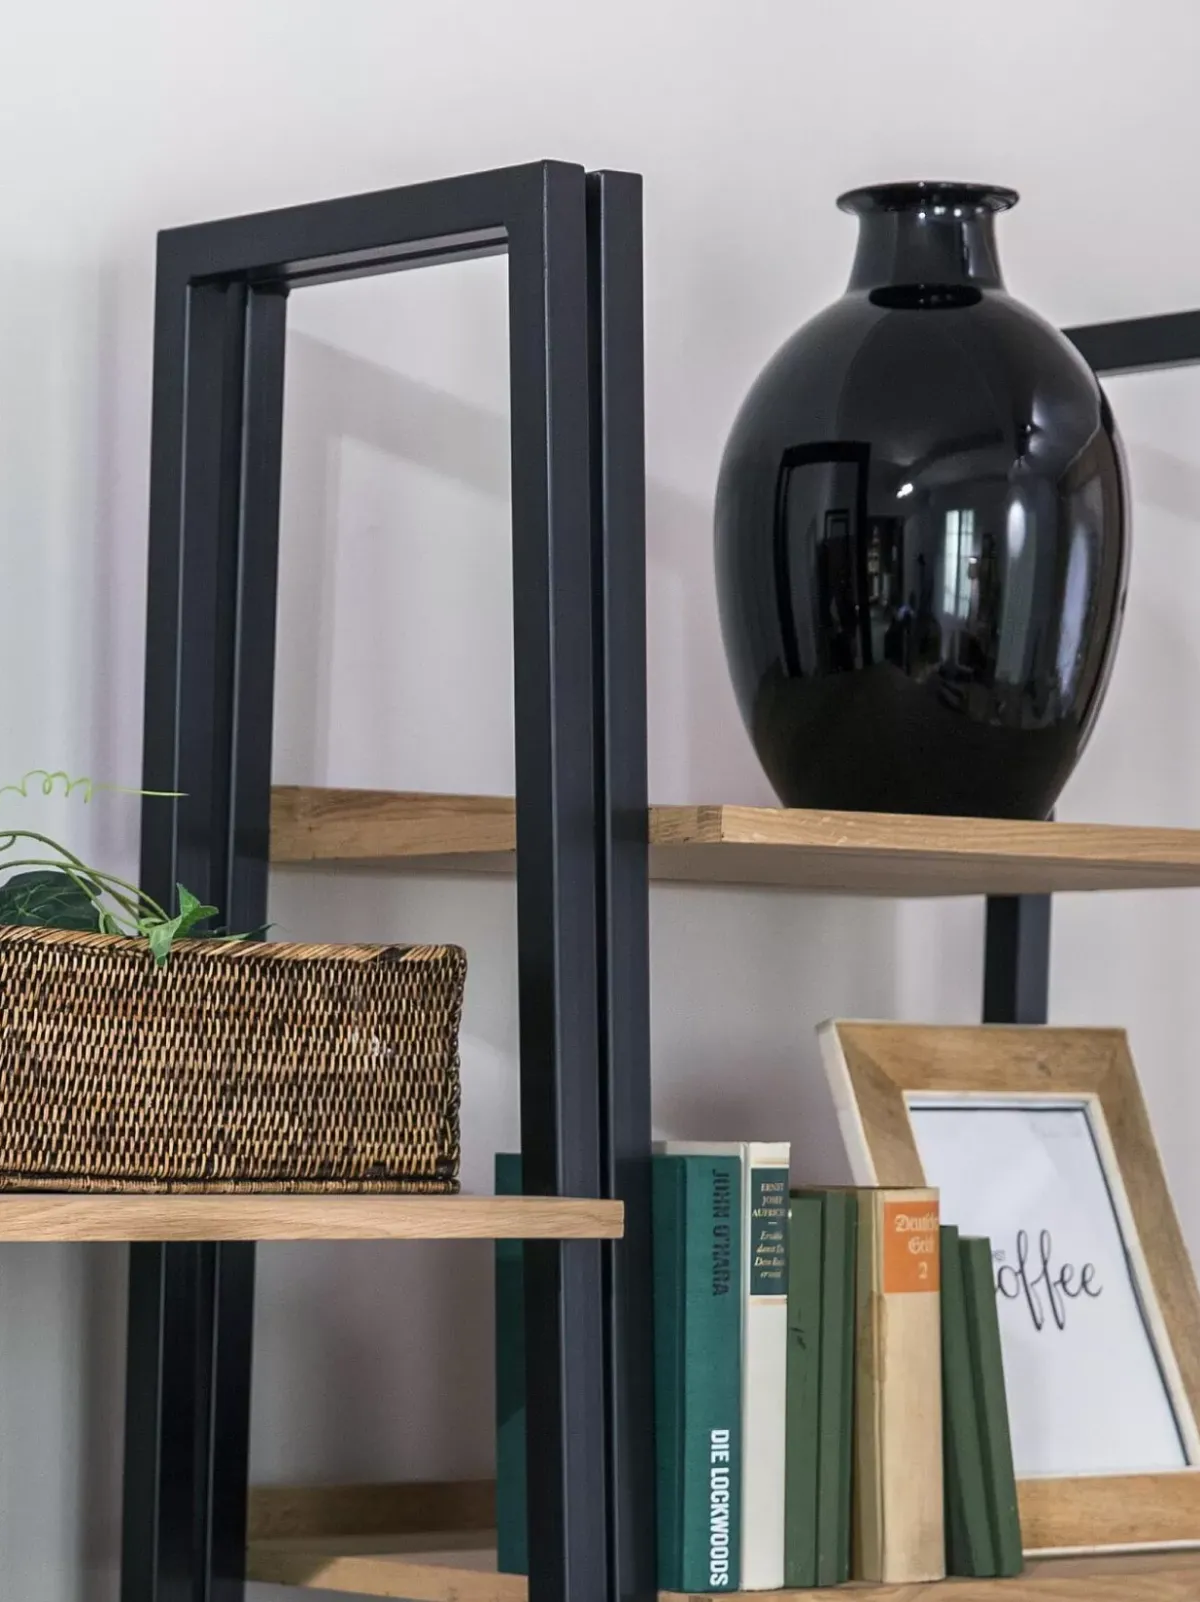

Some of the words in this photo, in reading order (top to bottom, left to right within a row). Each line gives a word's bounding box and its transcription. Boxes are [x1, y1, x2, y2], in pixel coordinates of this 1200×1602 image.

[712, 1168, 731, 1218] JOHN
[918, 1261, 929, 1280] 2
[994, 1229, 1104, 1332] offee
[710, 1429, 730, 1463] DIE
[709, 1467, 730, 1587] LOCKWOODS
